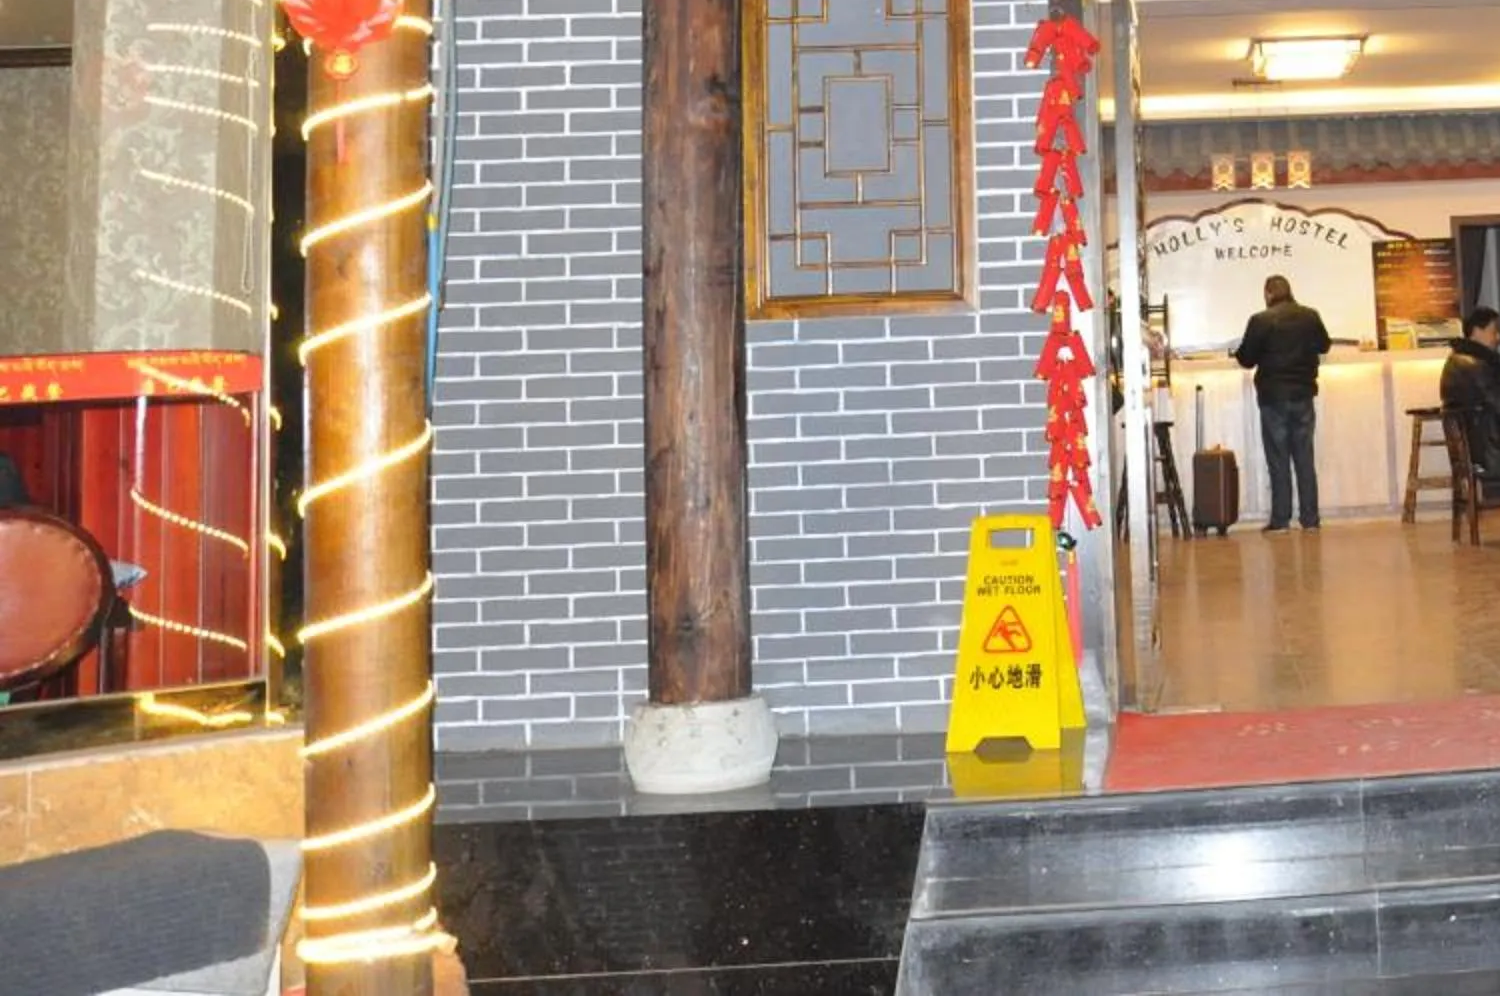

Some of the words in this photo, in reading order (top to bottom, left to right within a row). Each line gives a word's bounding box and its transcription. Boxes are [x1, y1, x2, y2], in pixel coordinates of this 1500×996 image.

[1153, 217, 1245, 256] HOLLY'S
[1270, 216, 1350, 250] HOSTEL
[1215, 244, 1293, 261] WELCOME
[983, 574, 1035, 586] CAUTION
[977, 586, 999, 597] WET
[1004, 585, 1041, 596] FLOOR
[969, 664, 1043, 690] 小心地滑
